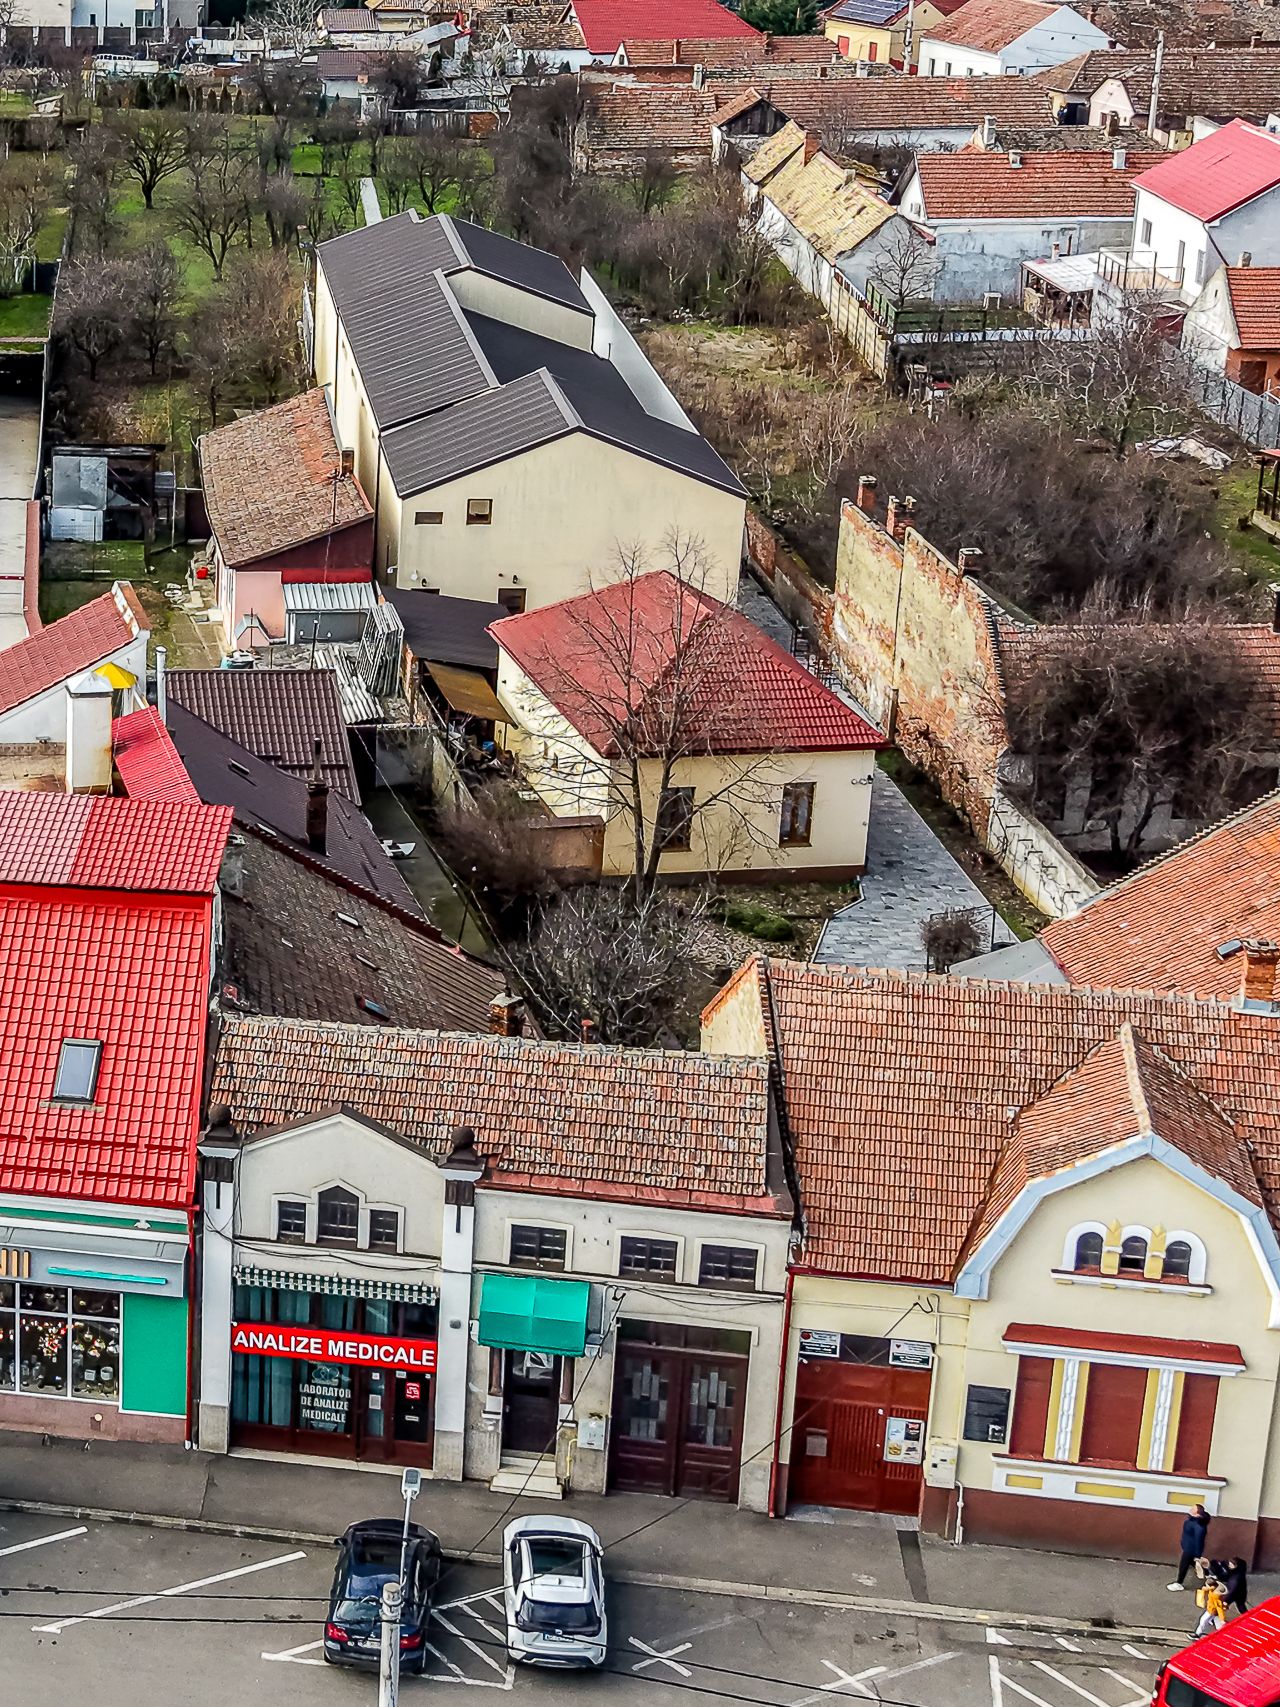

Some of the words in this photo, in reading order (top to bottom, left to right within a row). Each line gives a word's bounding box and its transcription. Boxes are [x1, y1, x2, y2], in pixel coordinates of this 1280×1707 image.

[234, 1330, 323, 1355] ANALIZE
[328, 1340, 435, 1366] MEDICALE
[301, 1396, 312, 1406] DE
[313, 1397, 349, 1411] ANALIZE
[302, 1408, 347, 1423] MEDICALE
